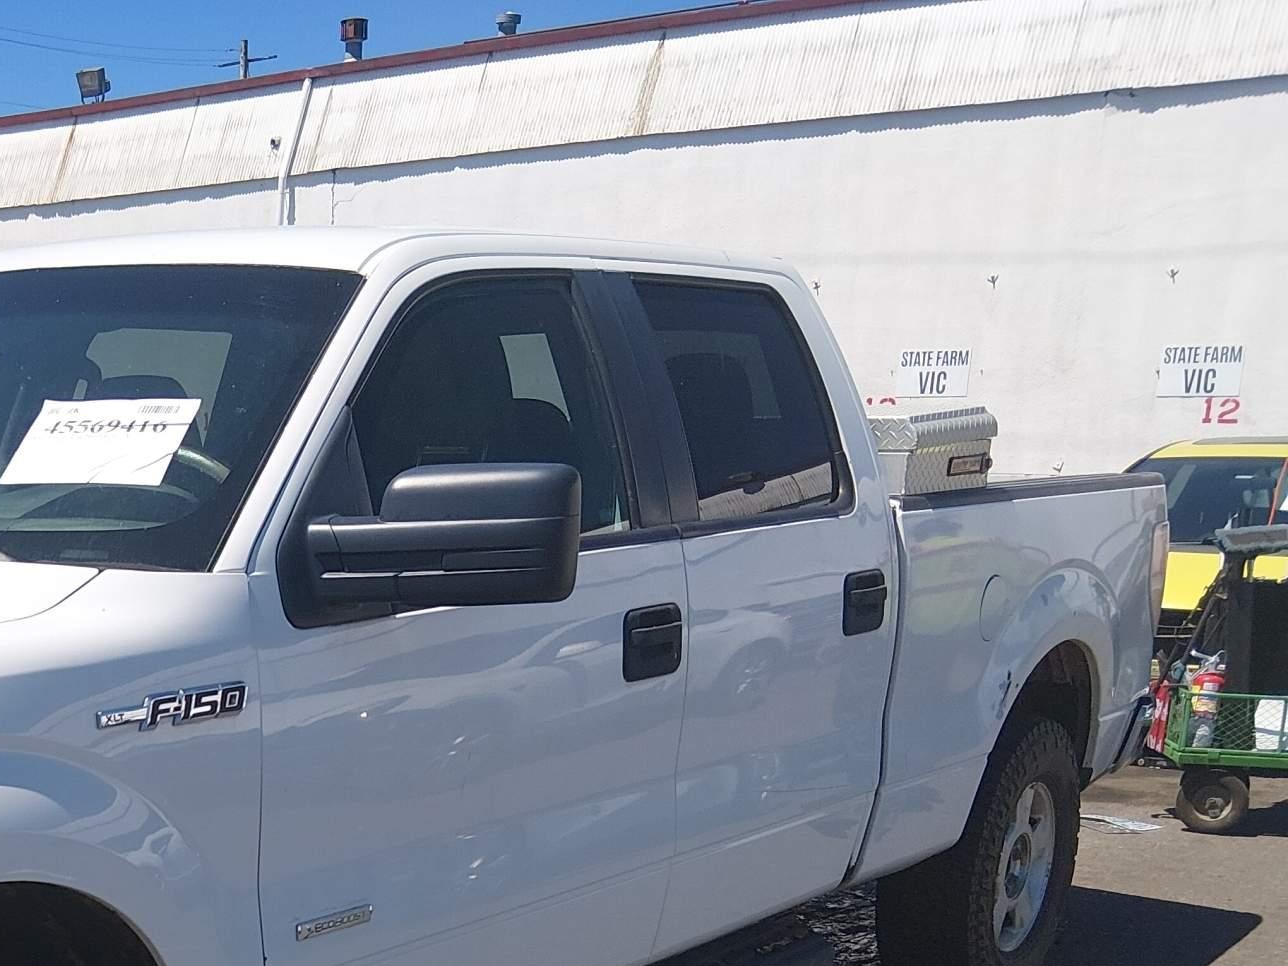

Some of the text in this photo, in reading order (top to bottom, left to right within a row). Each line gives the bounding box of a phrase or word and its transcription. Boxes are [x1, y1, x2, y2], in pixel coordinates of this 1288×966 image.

[901, 350, 970, 367] STATE FARM
[1163, 345, 1243, 364] STATE FARM
[919, 371, 947, 394] VIC
[1184, 368, 1217, 393] VIC
[1201, 397, 1240, 424] 12
[44, 419, 168, 434] 45569416
[105, 684, 248, 727] XLT F-150
